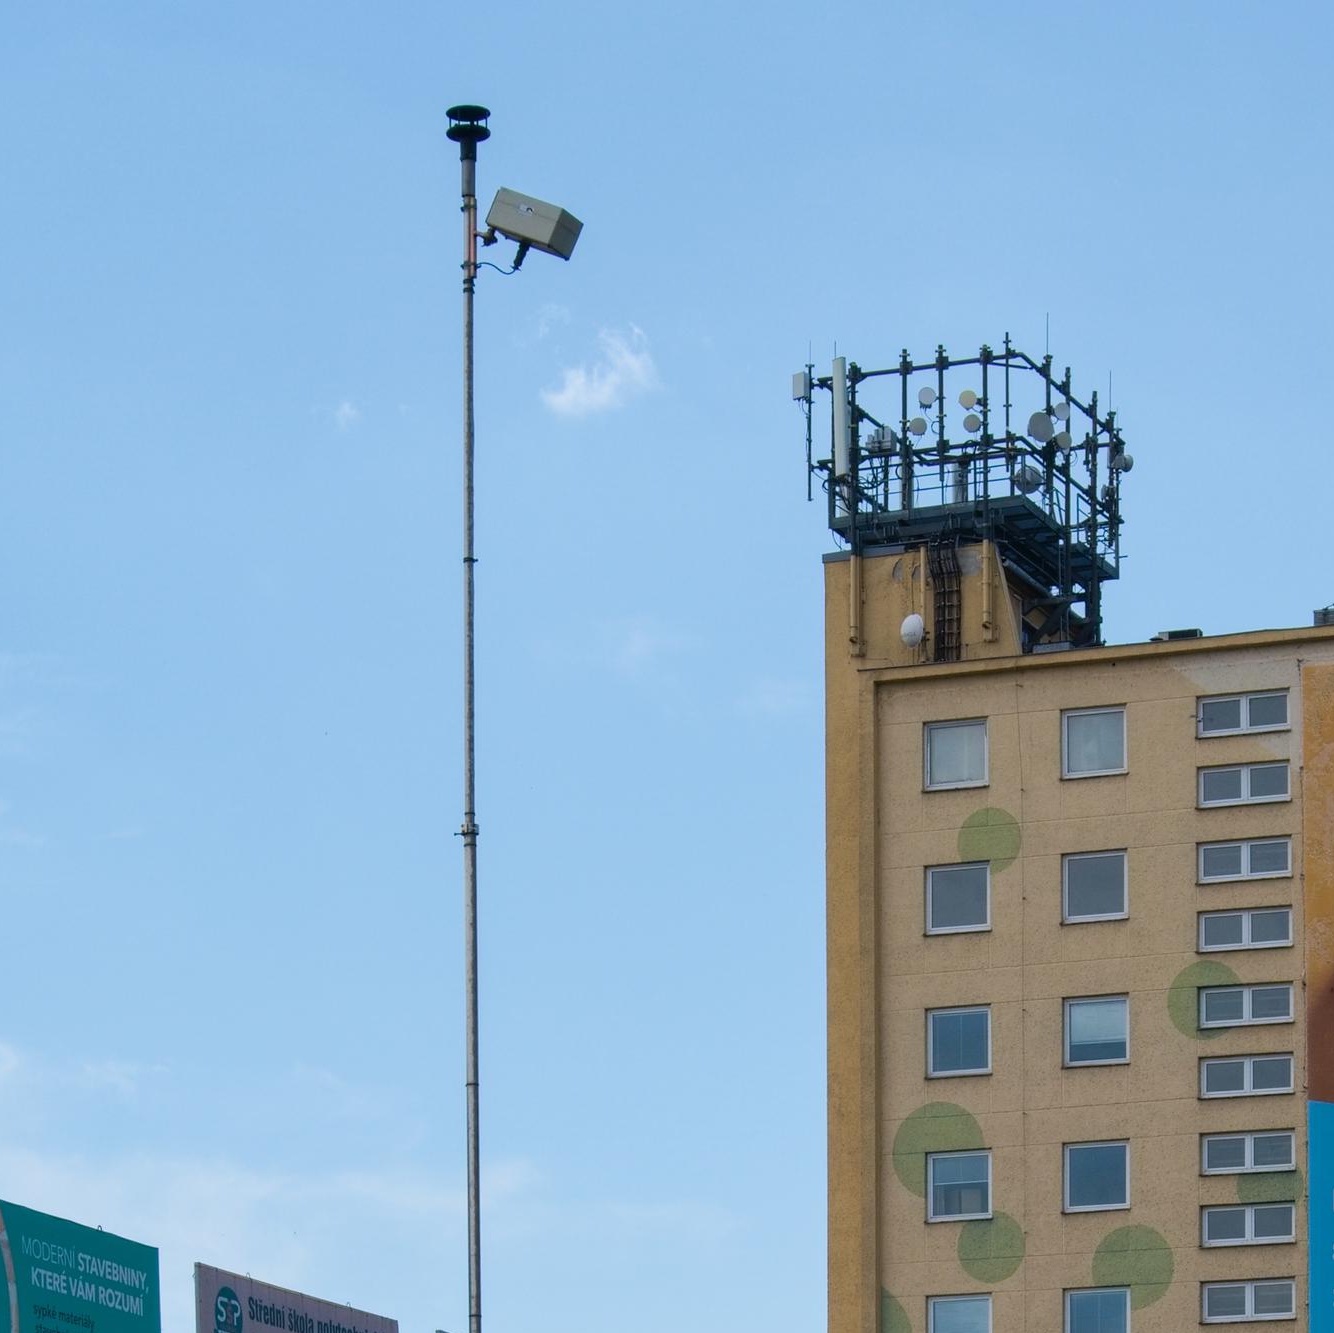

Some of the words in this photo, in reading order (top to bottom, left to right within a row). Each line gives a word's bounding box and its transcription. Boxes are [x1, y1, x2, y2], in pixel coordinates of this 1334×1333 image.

[21, 1234, 76, 1270] MODERNÍ
[78, 1252, 149, 1294] STAVEBNINY,
[31, 1266, 68, 1295] KTERÉ
[69, 1276, 96, 1303] VÁM
[98, 1286, 144, 1317] ROZUMÍ
[248, 1296, 286, 1331] Střední
